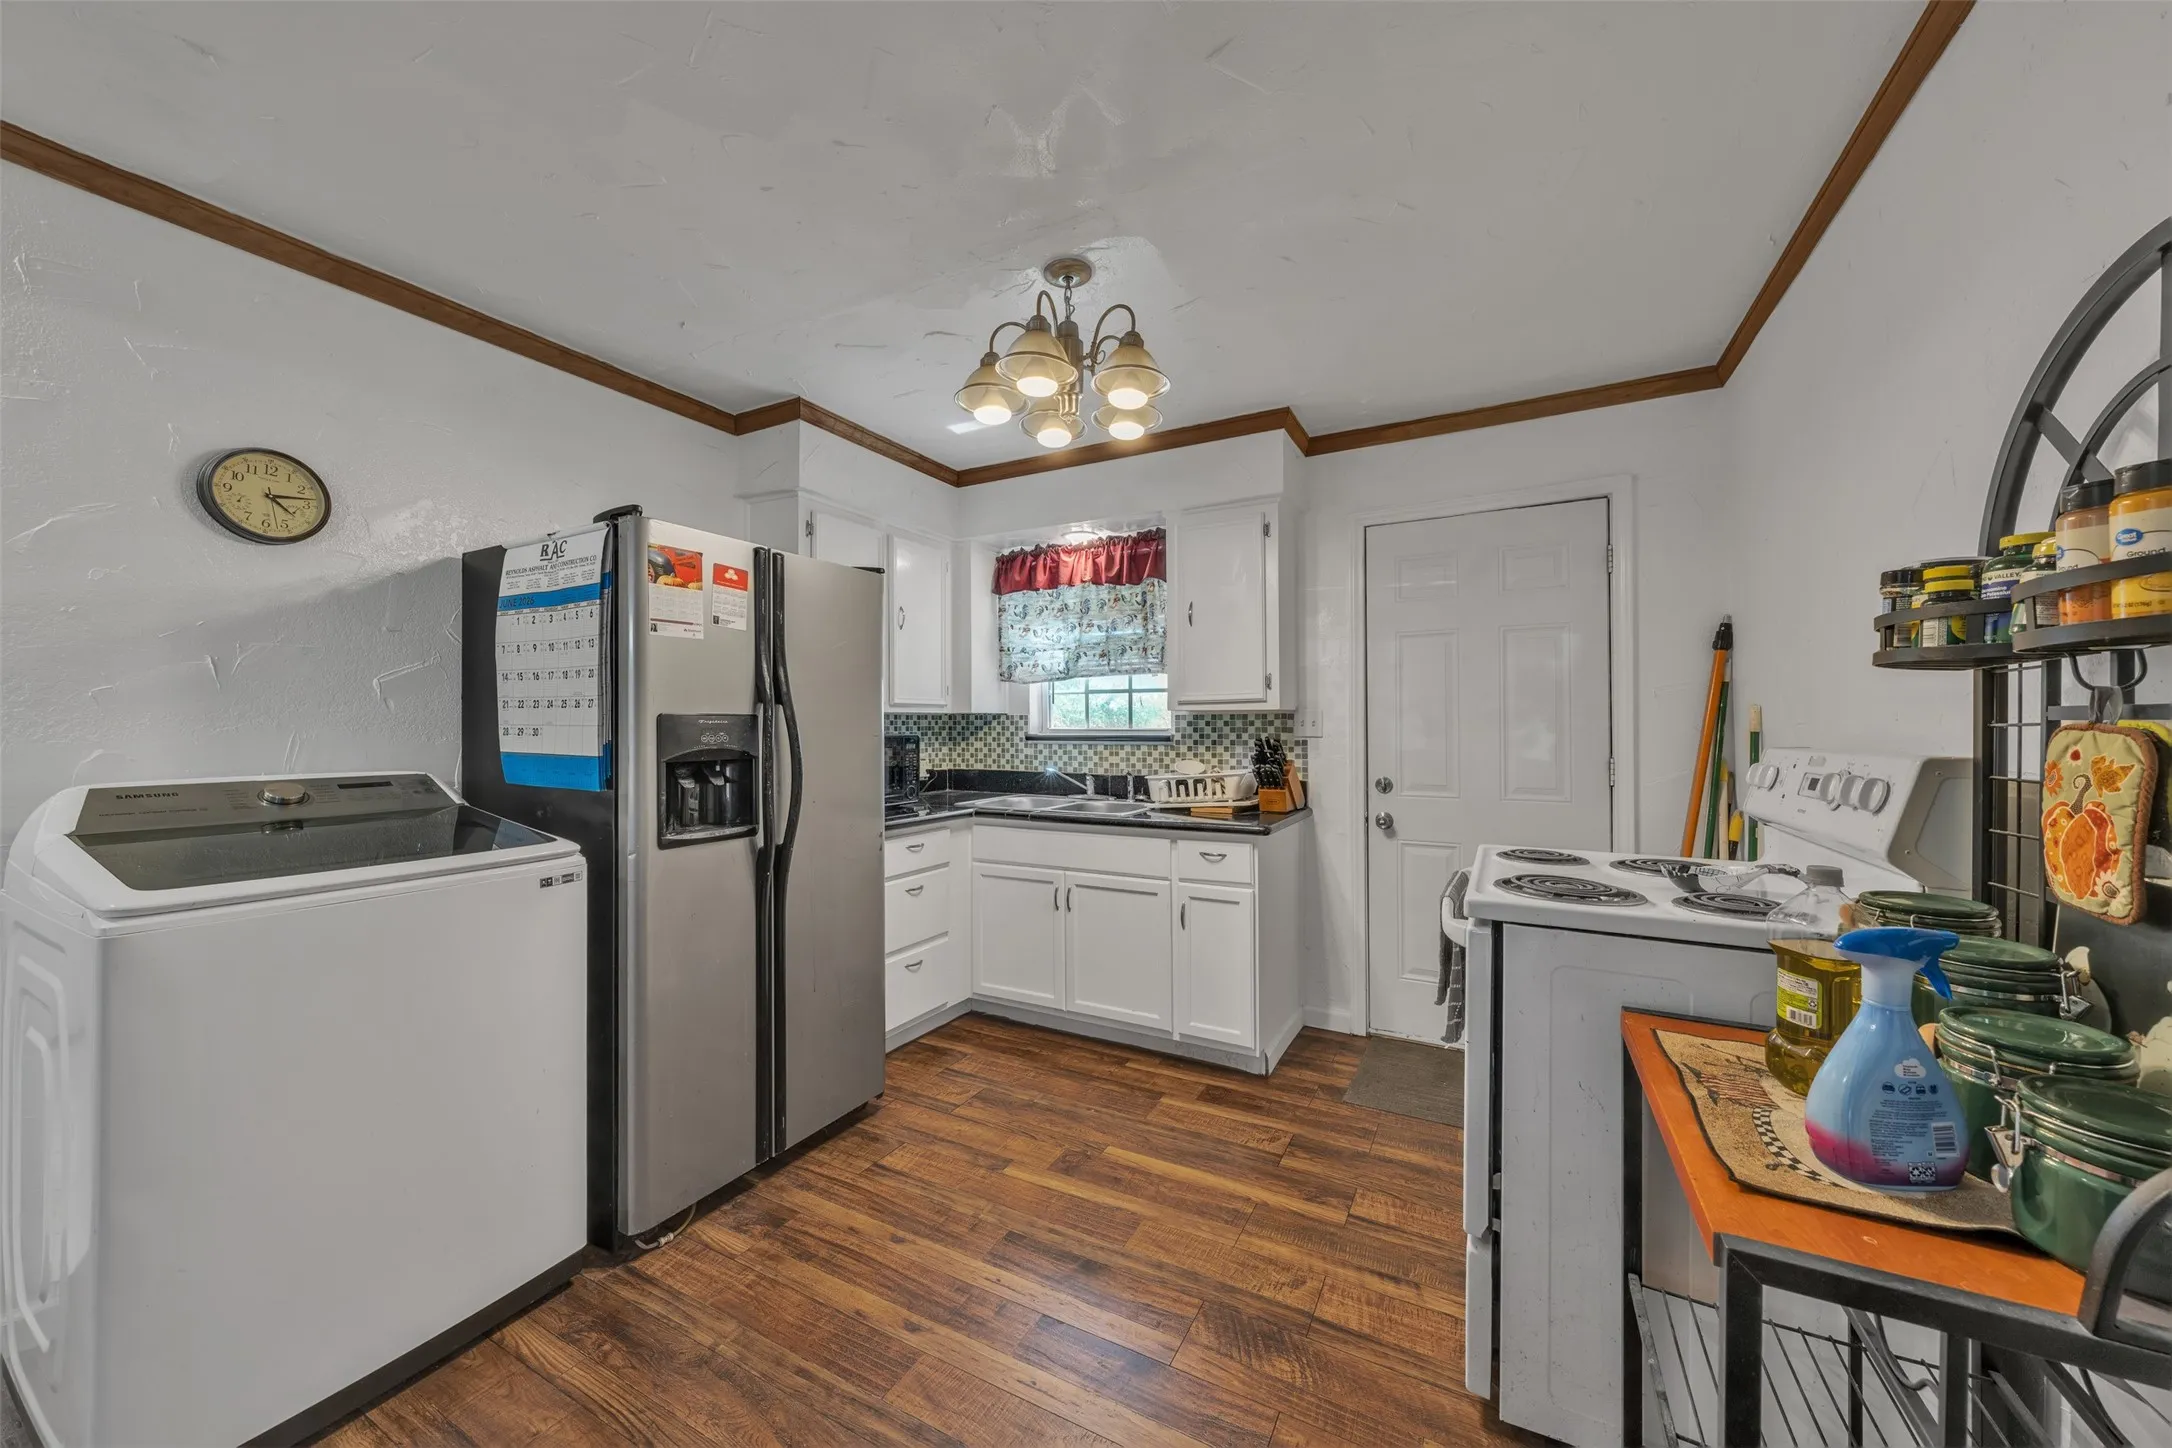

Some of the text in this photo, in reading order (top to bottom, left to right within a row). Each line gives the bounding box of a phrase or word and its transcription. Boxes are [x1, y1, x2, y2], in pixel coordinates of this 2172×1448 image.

[246, 463, 258, 475] 11
[263, 463, 279, 477] 12
[231, 470, 245, 482] 10
[286, 473, 292, 483] 1
[222, 482, 233, 493] 9
[297, 485, 306, 495] 2
[302, 500, 311, 510] 3
[244, 511, 252, 521] 7
[261, 519, 271, 528] 6
[280, 519, 289, 529] 5
[540, 540, 568, 560] RAC
[499, 598, 517, 608] JUNE
[516, 609, 593, 625] 1 2 3 4 5 6
[501, 639, 594, 654] 7 8 9 10 11 12 13
[502, 669, 594, 682] 14 15 16 17 18 19 20
[502, 699, 594, 709] 21 22 23 24 25 26 27
[502, 727, 539, 736] 28 29 30
[115, 791, 179, 800] SAMSUNG
